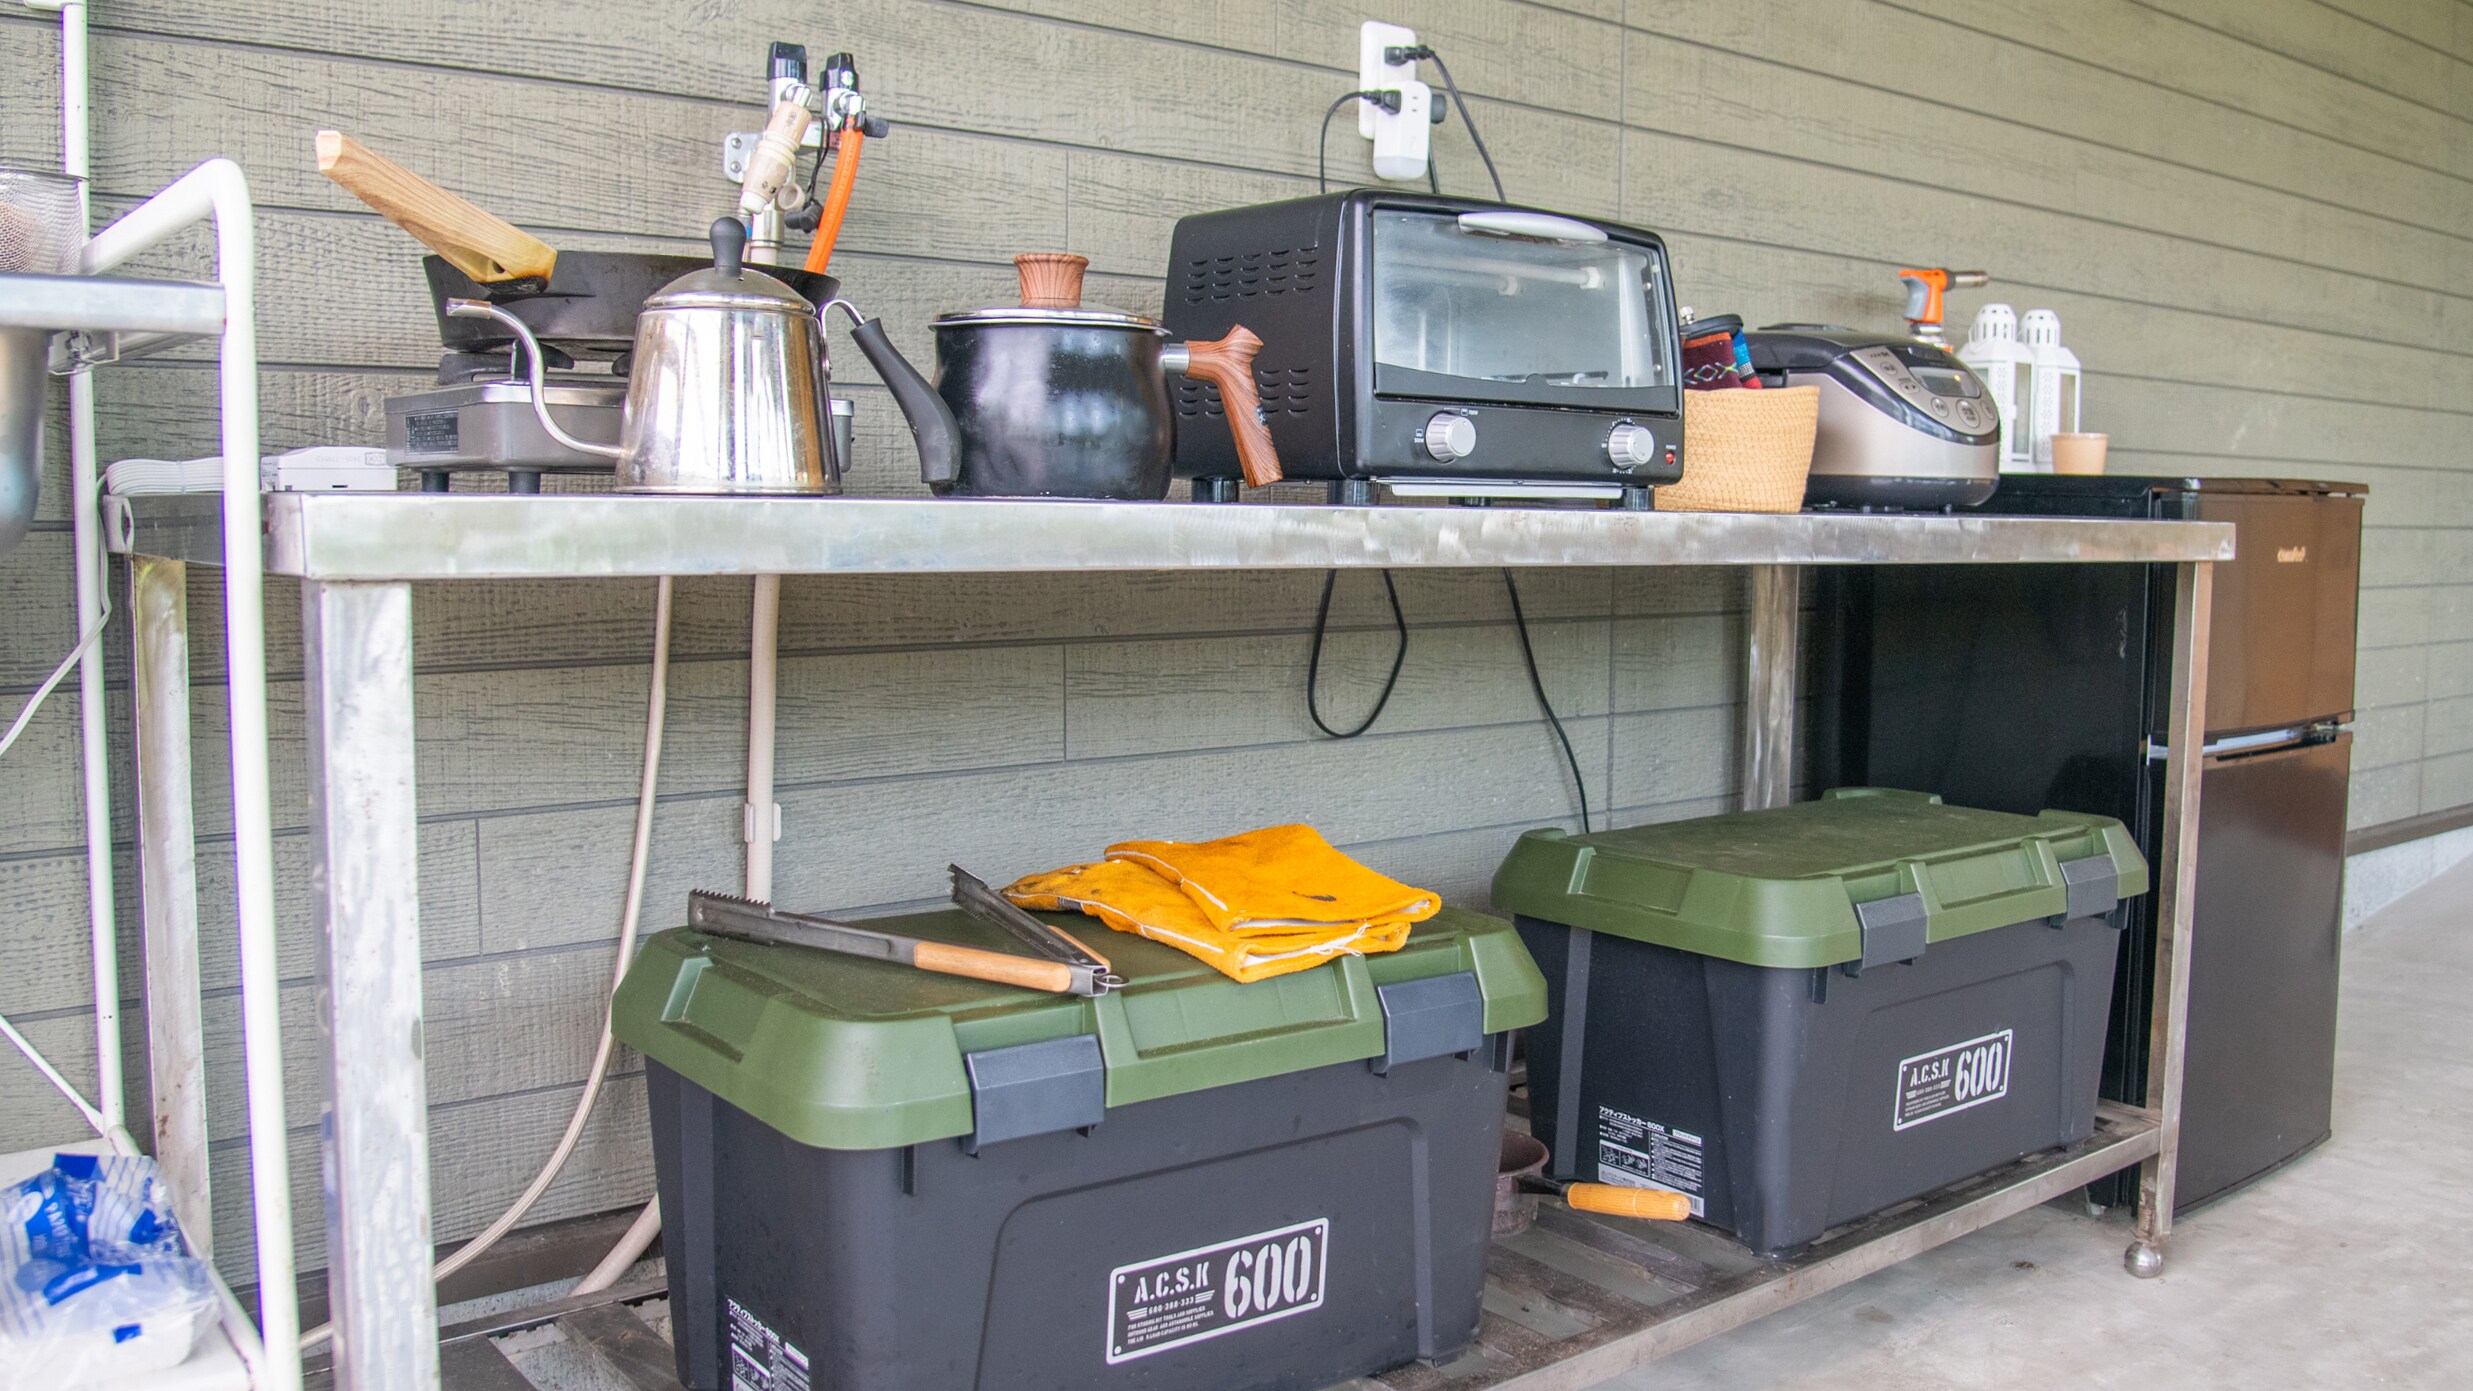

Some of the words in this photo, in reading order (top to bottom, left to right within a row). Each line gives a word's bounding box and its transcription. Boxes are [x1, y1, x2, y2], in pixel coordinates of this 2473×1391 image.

[1910, 1058, 1950, 1087] A.C.S.K
[1955, 1042, 2002, 1102] 600
[1134, 1262, 1209, 1304] A.C.S.K
[1224, 1236, 1312, 1318] 600
